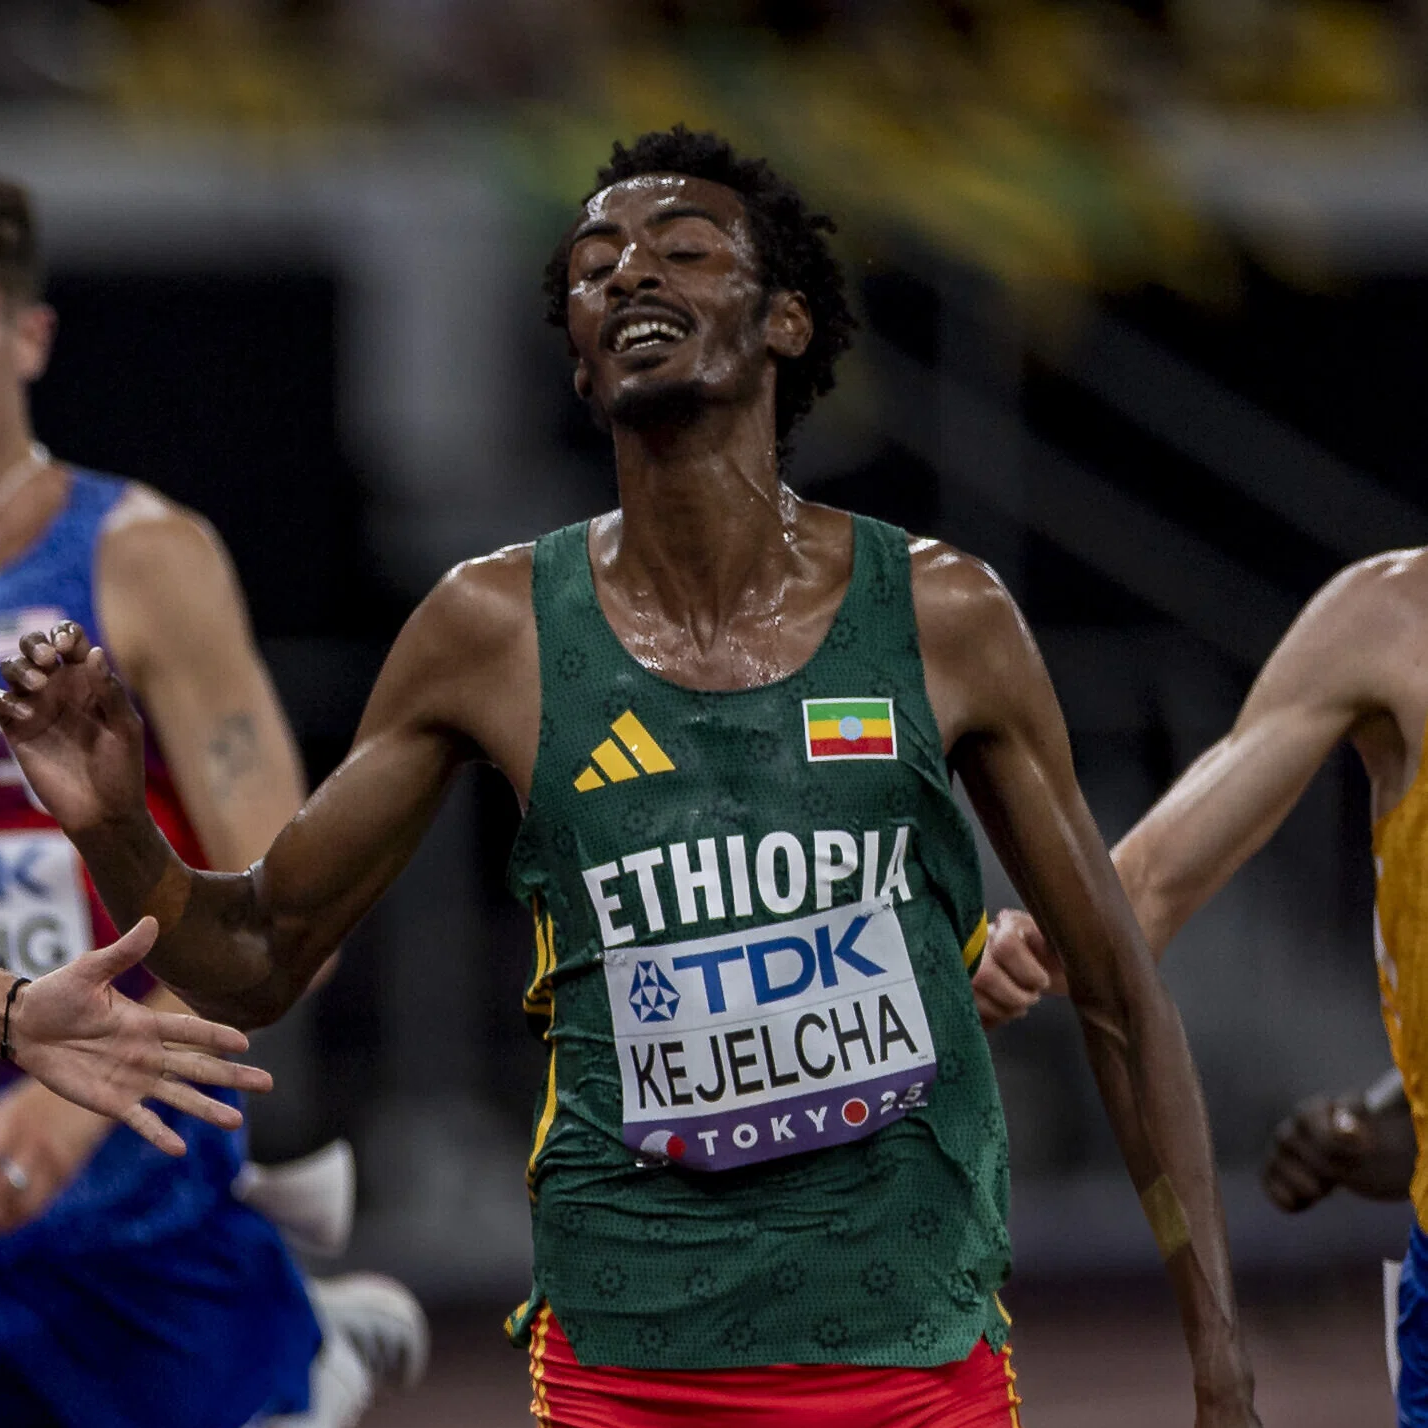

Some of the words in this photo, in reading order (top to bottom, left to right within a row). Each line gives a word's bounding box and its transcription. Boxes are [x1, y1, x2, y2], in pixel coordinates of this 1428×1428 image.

[582, 826, 911, 948] ETHIOPIA
[672, 913, 887, 1014] TDK
[629, 994, 918, 1109] KEJELCHA
